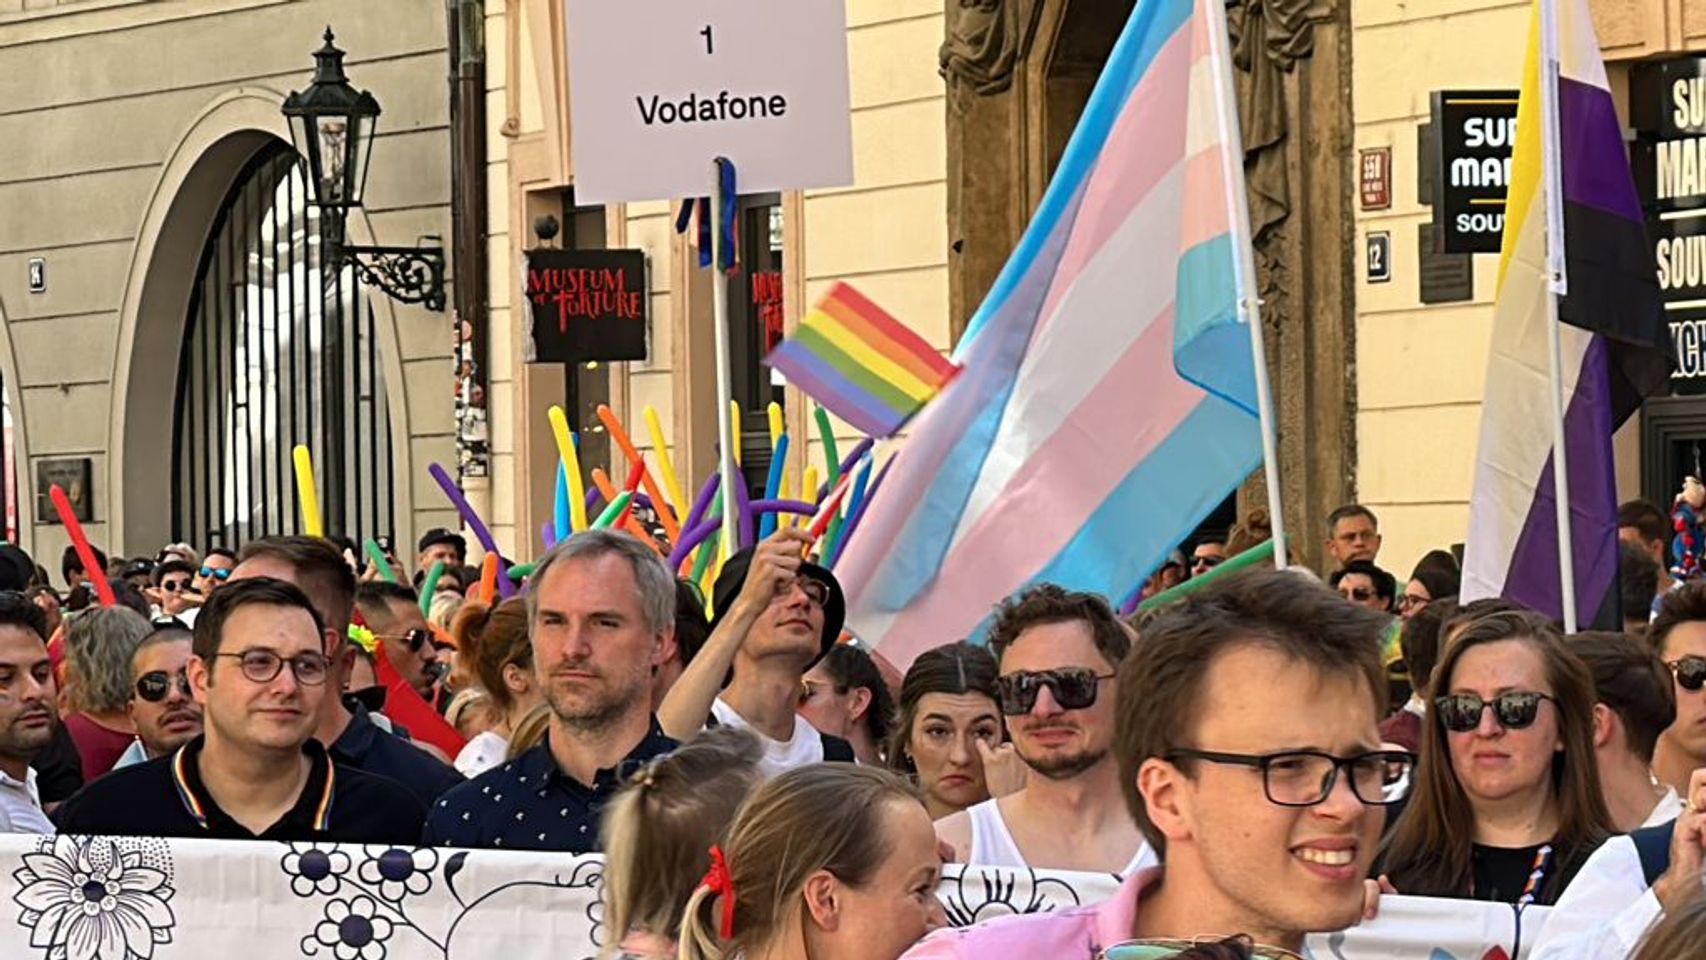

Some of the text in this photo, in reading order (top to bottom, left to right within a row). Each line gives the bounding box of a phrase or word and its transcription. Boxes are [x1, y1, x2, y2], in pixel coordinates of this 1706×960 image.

[700, 25, 713, 54] 1
[636, 91, 787, 125] Vodafone
[1451, 158, 1512, 187] MA
[1456, 213, 1505, 232] SOU
[1368, 243, 1382, 270] 12
[529, 267, 625, 293] MUSEUM
